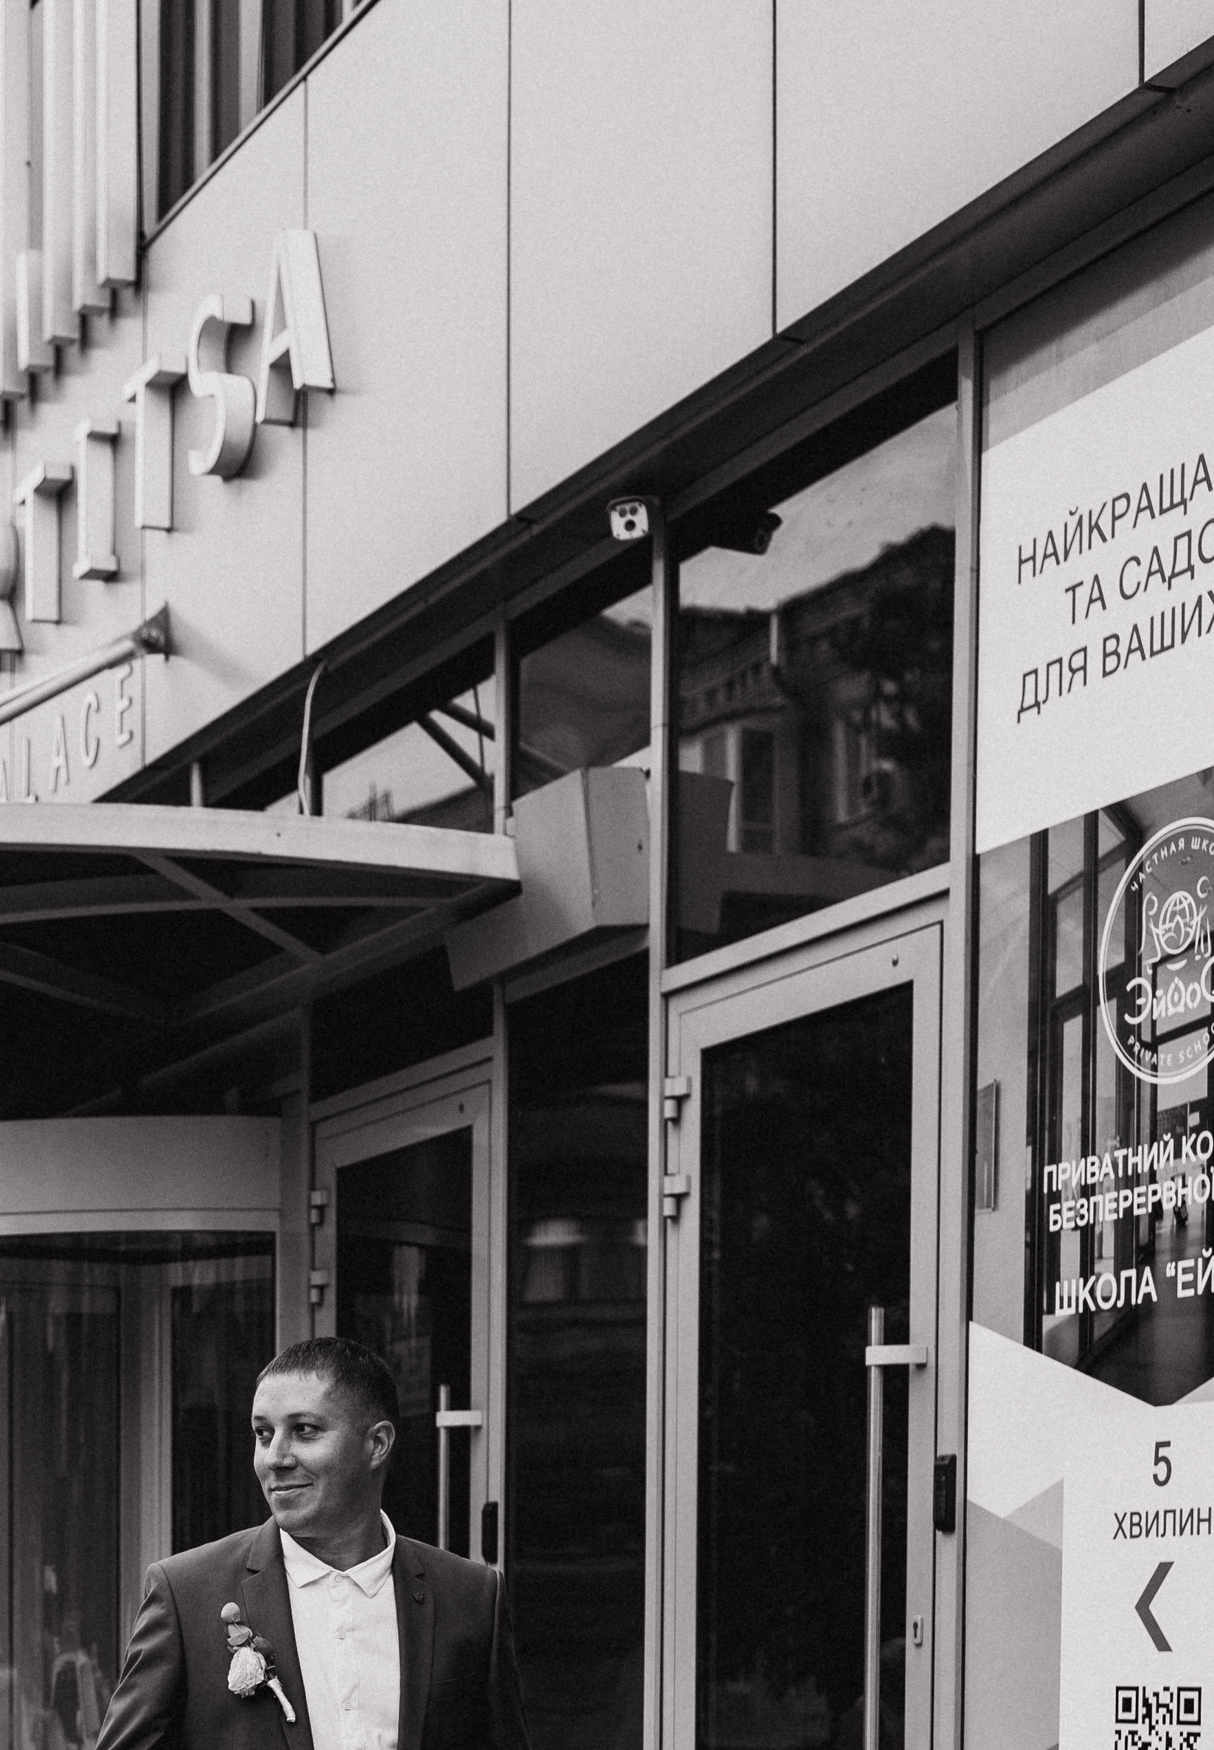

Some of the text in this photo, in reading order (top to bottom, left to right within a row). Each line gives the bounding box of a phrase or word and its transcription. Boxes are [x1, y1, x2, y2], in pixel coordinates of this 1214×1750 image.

[1017, 452, 1214, 585] НАЙКРАЩА
[1064, 573, 1107, 625] ТА
[1017, 645, 1088, 724] ДЛЯ
[1130, 837, 1186, 892] ЧАСТНАЯ
[1127, 1034, 1173, 1067] PRIVATE
[1043, 1130, 1214, 1194] ПРИВАТНИЙ КО
[1054, 1265, 1158, 1317] ШКОЛА
[1152, 1440, 1173, 1487] 5
[1112, 1506, 1213, 1540] ХВИЛИН
